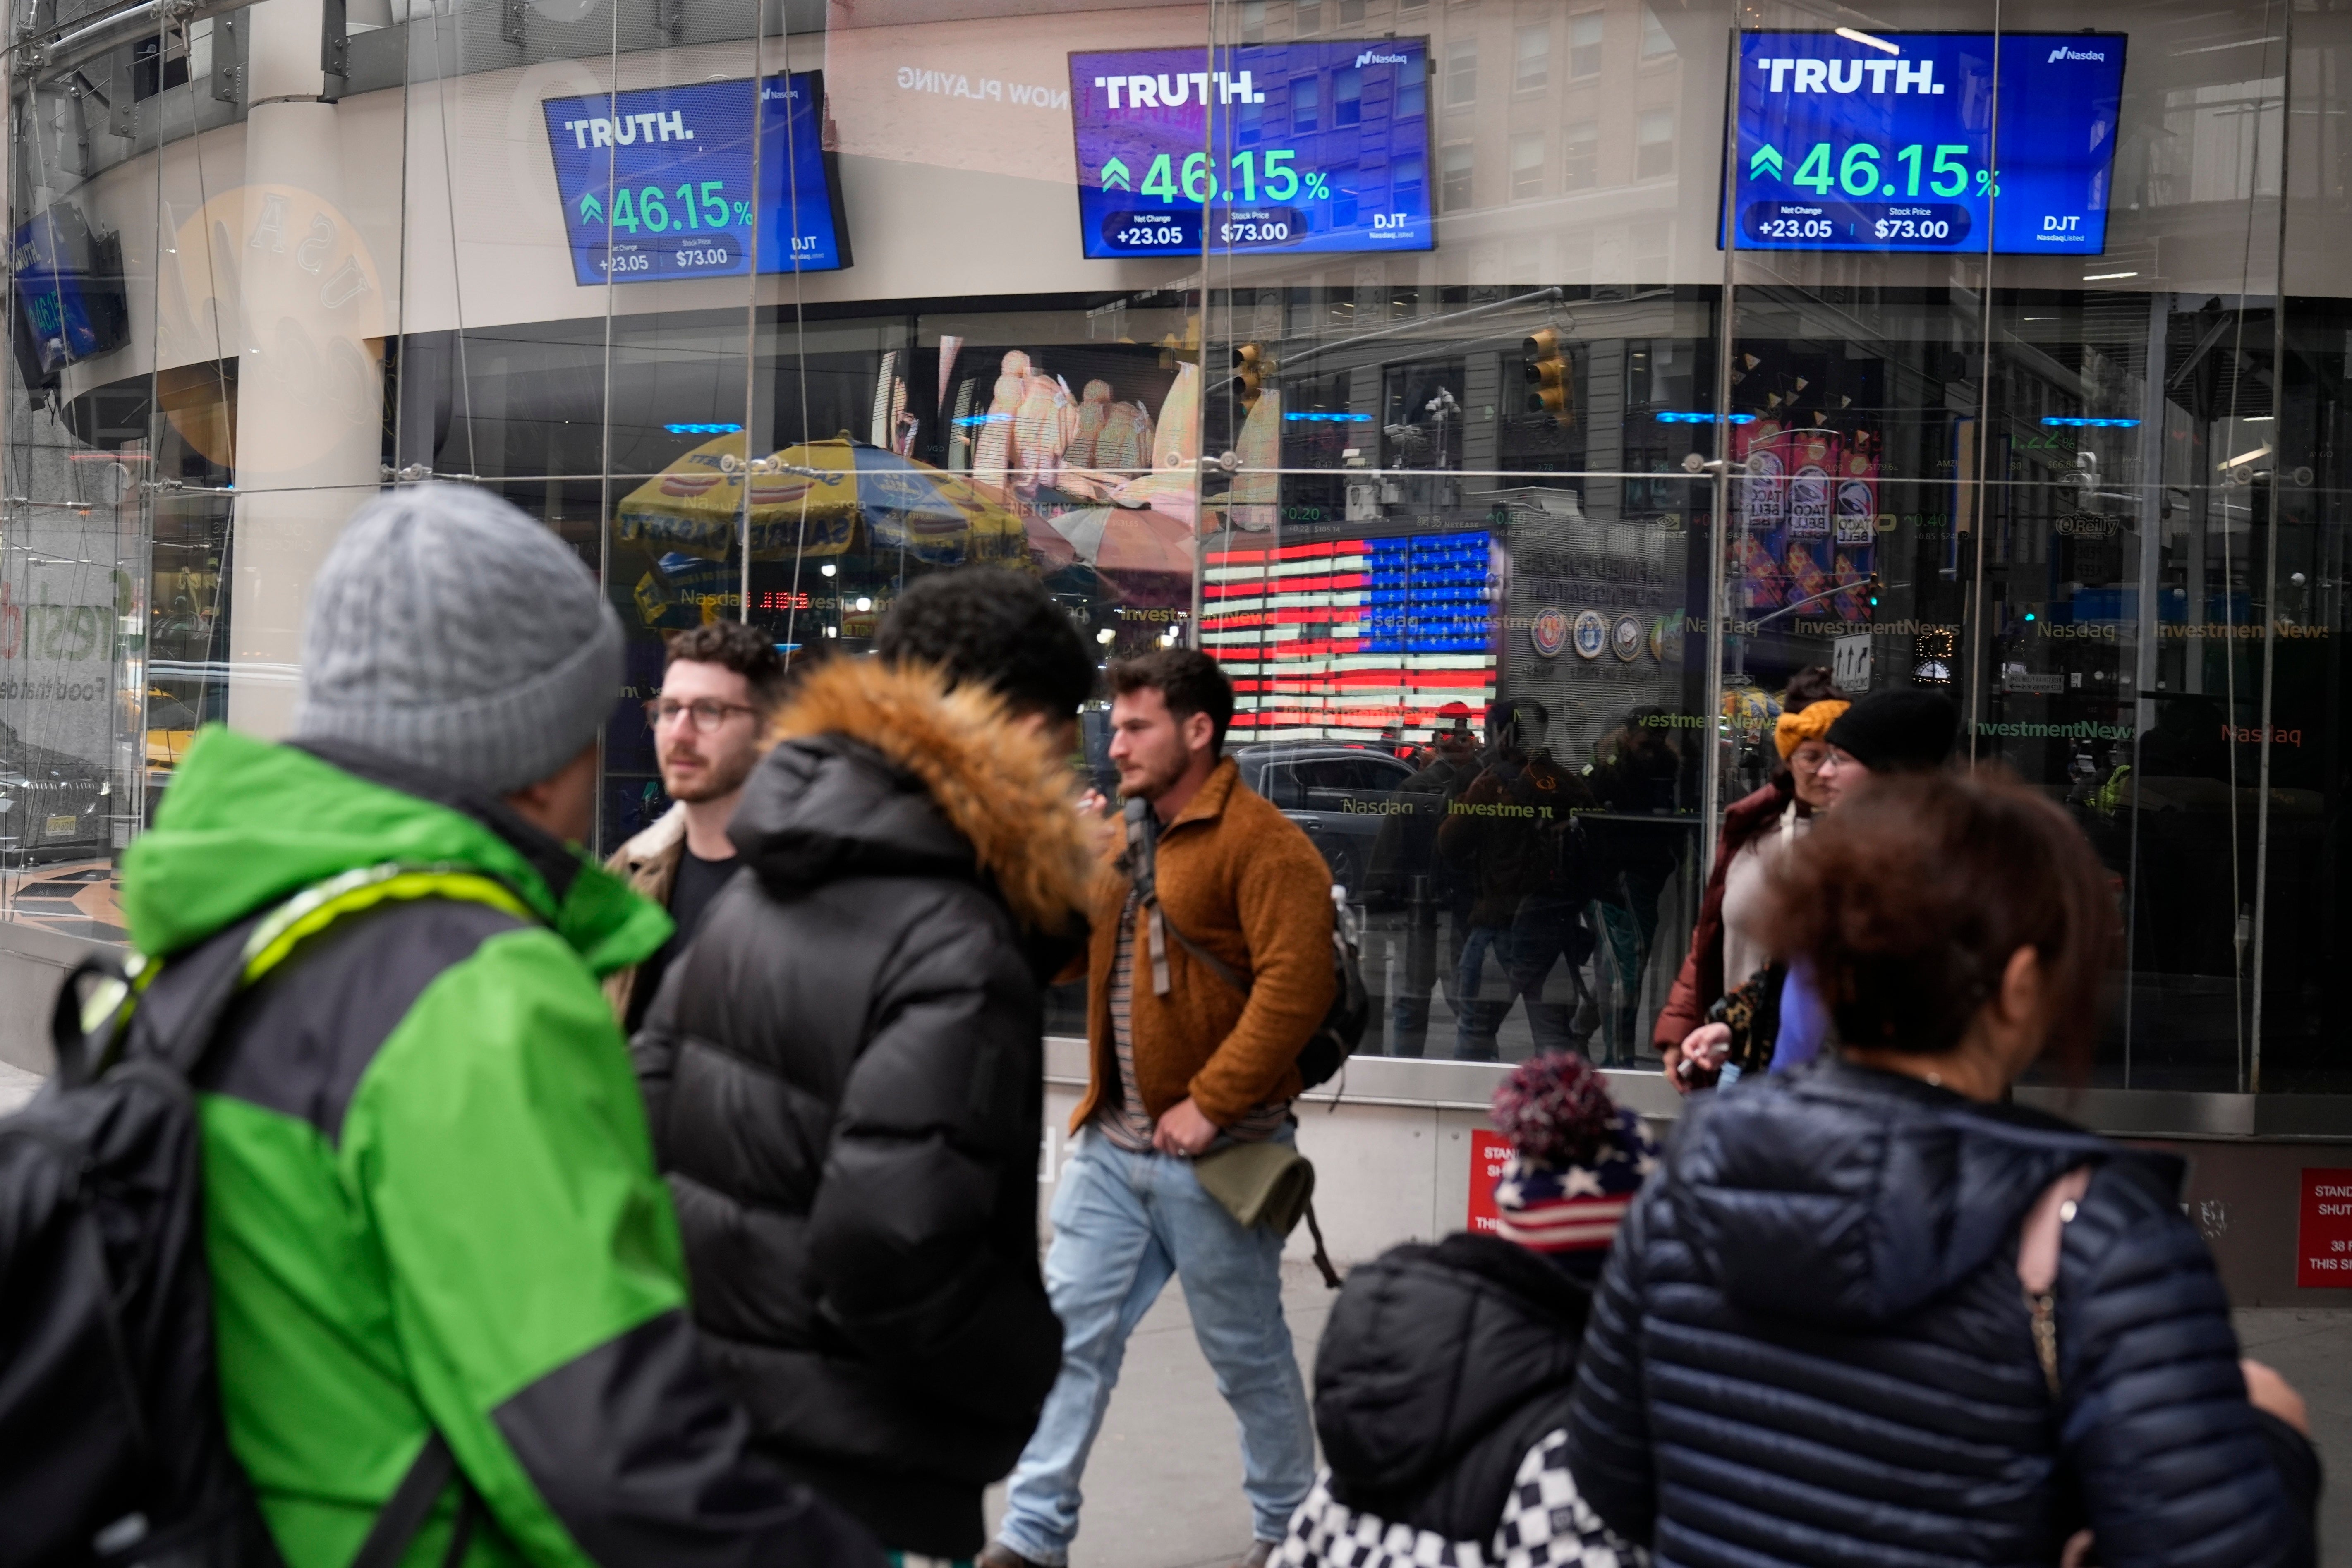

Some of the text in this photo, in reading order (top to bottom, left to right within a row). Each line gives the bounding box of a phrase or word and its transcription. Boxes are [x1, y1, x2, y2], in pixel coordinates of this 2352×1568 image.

[1372, 53, 1407, 65] Nasdaq
[2067, 49, 2104, 62] Nasdaq
[1758, 59, 1944, 94] TRUTH.
[1095, 71, 1265, 108] TRUTH.
[565, 111, 694, 149] TRUTH.
[1140, 149, 1329, 204] 46.15%
[1793, 142, 2000, 198] 46.15%
[1134, 214, 1171, 224] Net Change
[1251, 211, 1269, 219] Price
[1797, 206, 1822, 216] Change
[1911, 208, 1931, 216] Price
[1374, 213, 1406, 229] DJT
[1759, 220, 1832, 239] +23.05
[1875, 220, 1949, 239] $73.00
[2043, 215, 2080, 230] DJT
[1117, 225, 1182, 245] +23.05
[1221, 222, 1288, 243] $73.00
[599, 255, 649, 271] +23.05
[676, 249, 727, 268] $73.00
[1348, 611, 1418, 629] Nasdaq
[1686, 617, 1960, 638] Nadaq InvestmentNews
[2038, 620, 2329, 641] Nasdaq InvestmenNews
[2309, 1258, 2338, 1270] THIS
